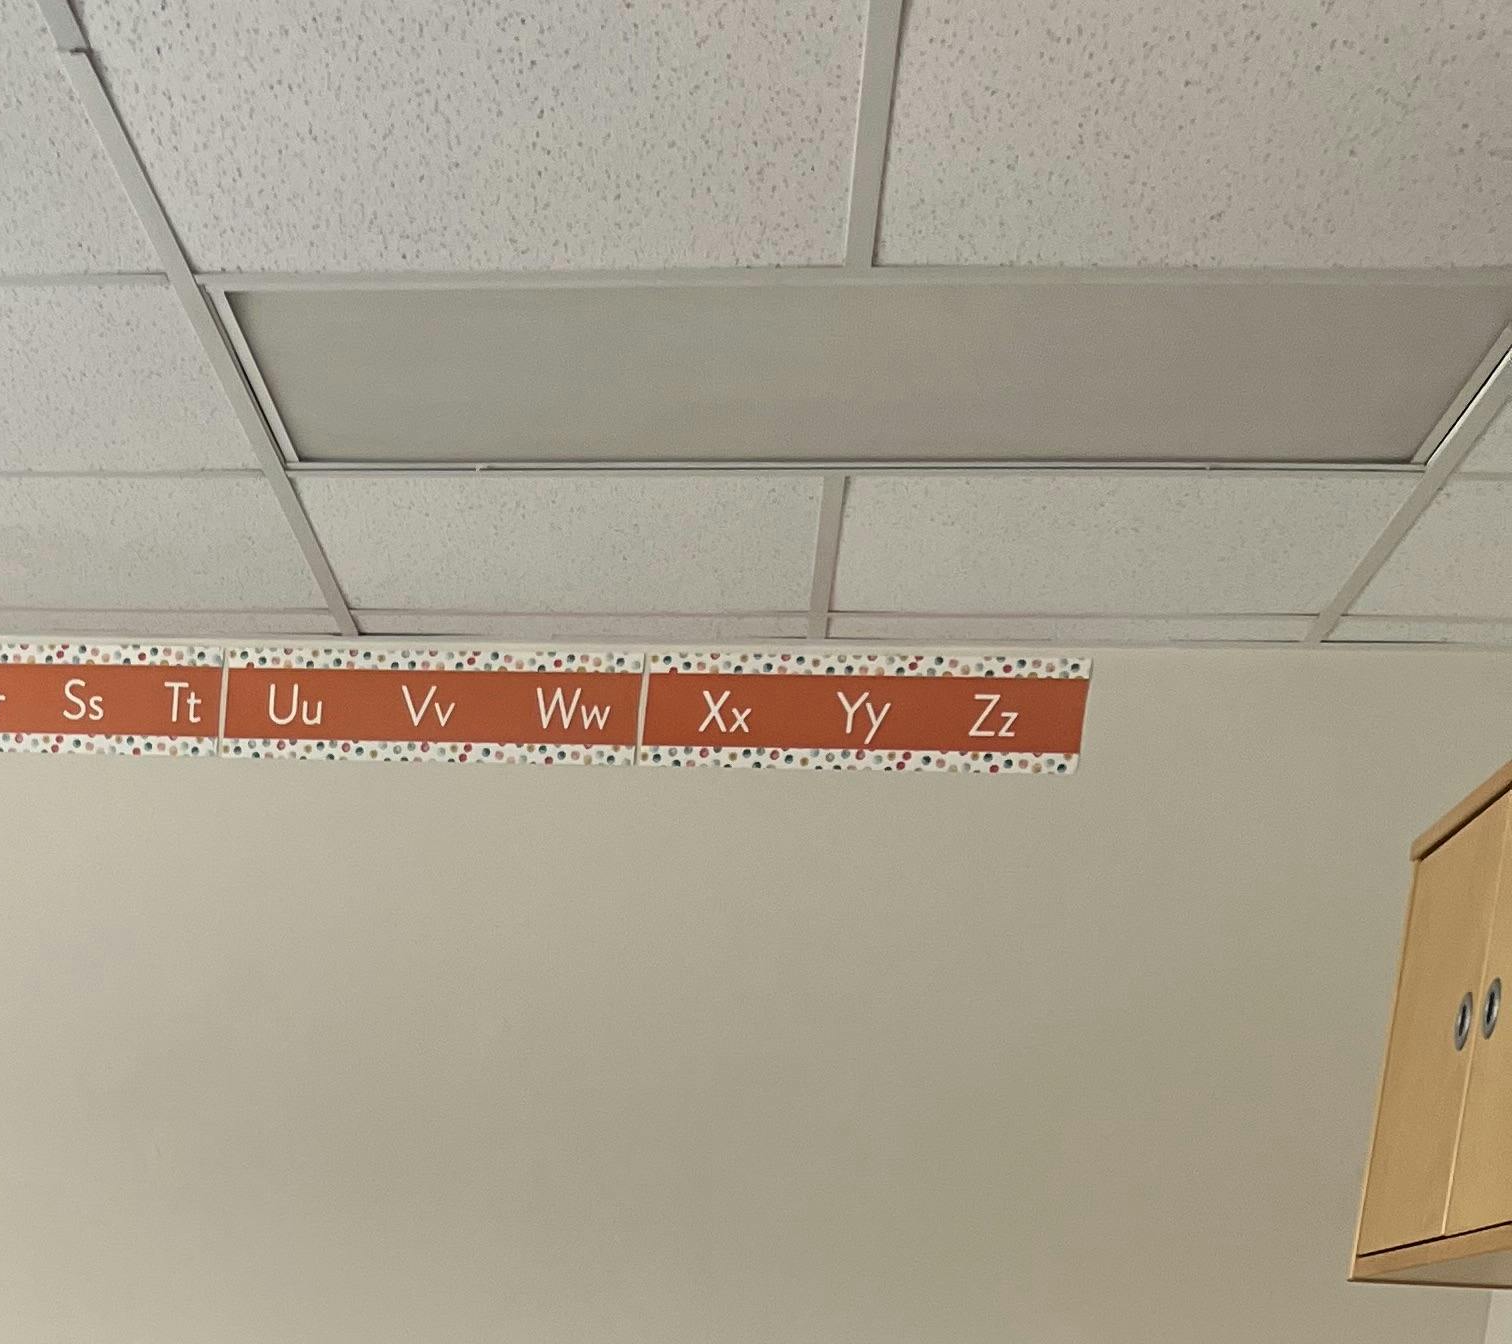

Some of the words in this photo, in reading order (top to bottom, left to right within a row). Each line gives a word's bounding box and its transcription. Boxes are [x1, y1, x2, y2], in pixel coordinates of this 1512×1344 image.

[64, 679, 103, 720] Ss
[165, 682, 201, 722] Tt
[269, 684, 322, 724] Uu
[402, 686, 455, 726] Vv
[537, 688, 610, 729] Ww
[699, 691, 751, 732] Xx
[838, 692, 890, 744] Yy
[969, 694, 1018, 736] Zz
